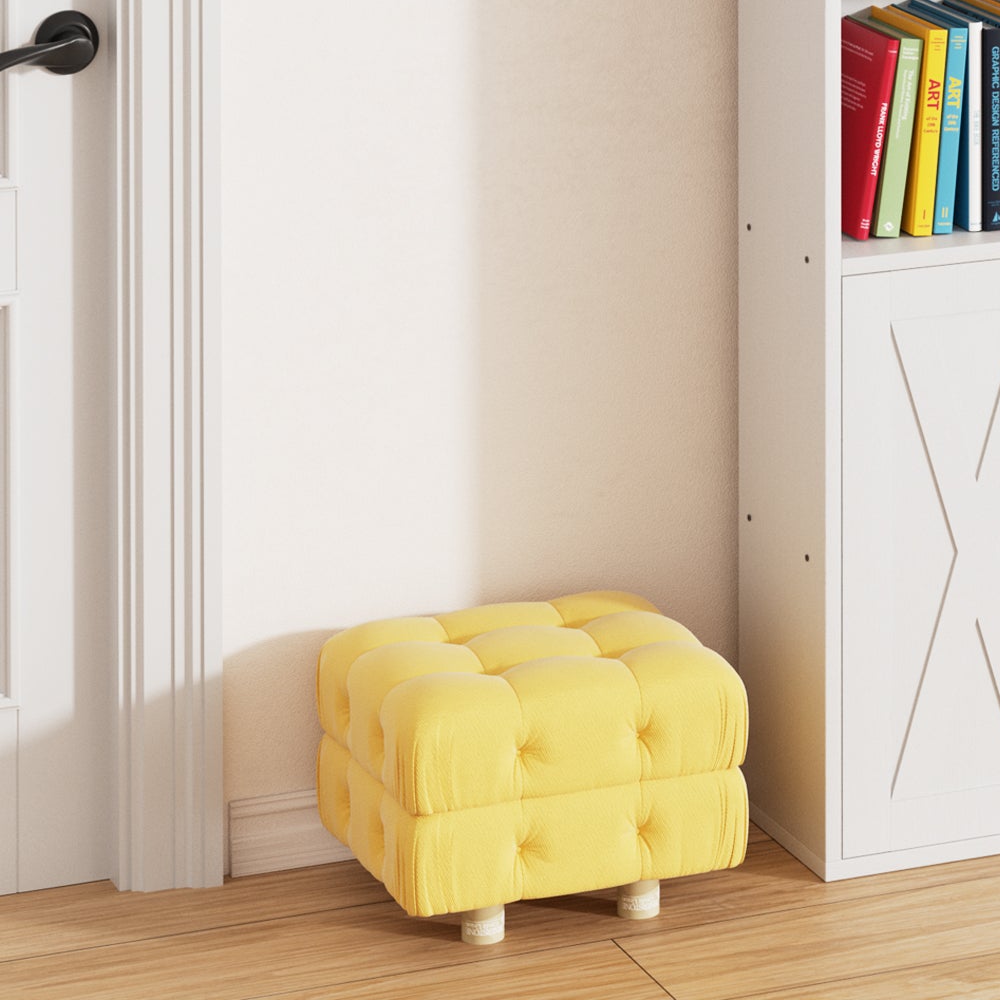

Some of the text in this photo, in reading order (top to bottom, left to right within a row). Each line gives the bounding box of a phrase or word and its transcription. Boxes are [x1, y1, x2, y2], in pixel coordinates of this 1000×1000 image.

[926, 79, 942, 110] ART
[947, 76, 963, 109] ART
[991, 46, 1000, 192] GRAPHIC DESIGN REFERENCED
[870, 102, 889, 176] FRANK LLOYD WRIGHT
